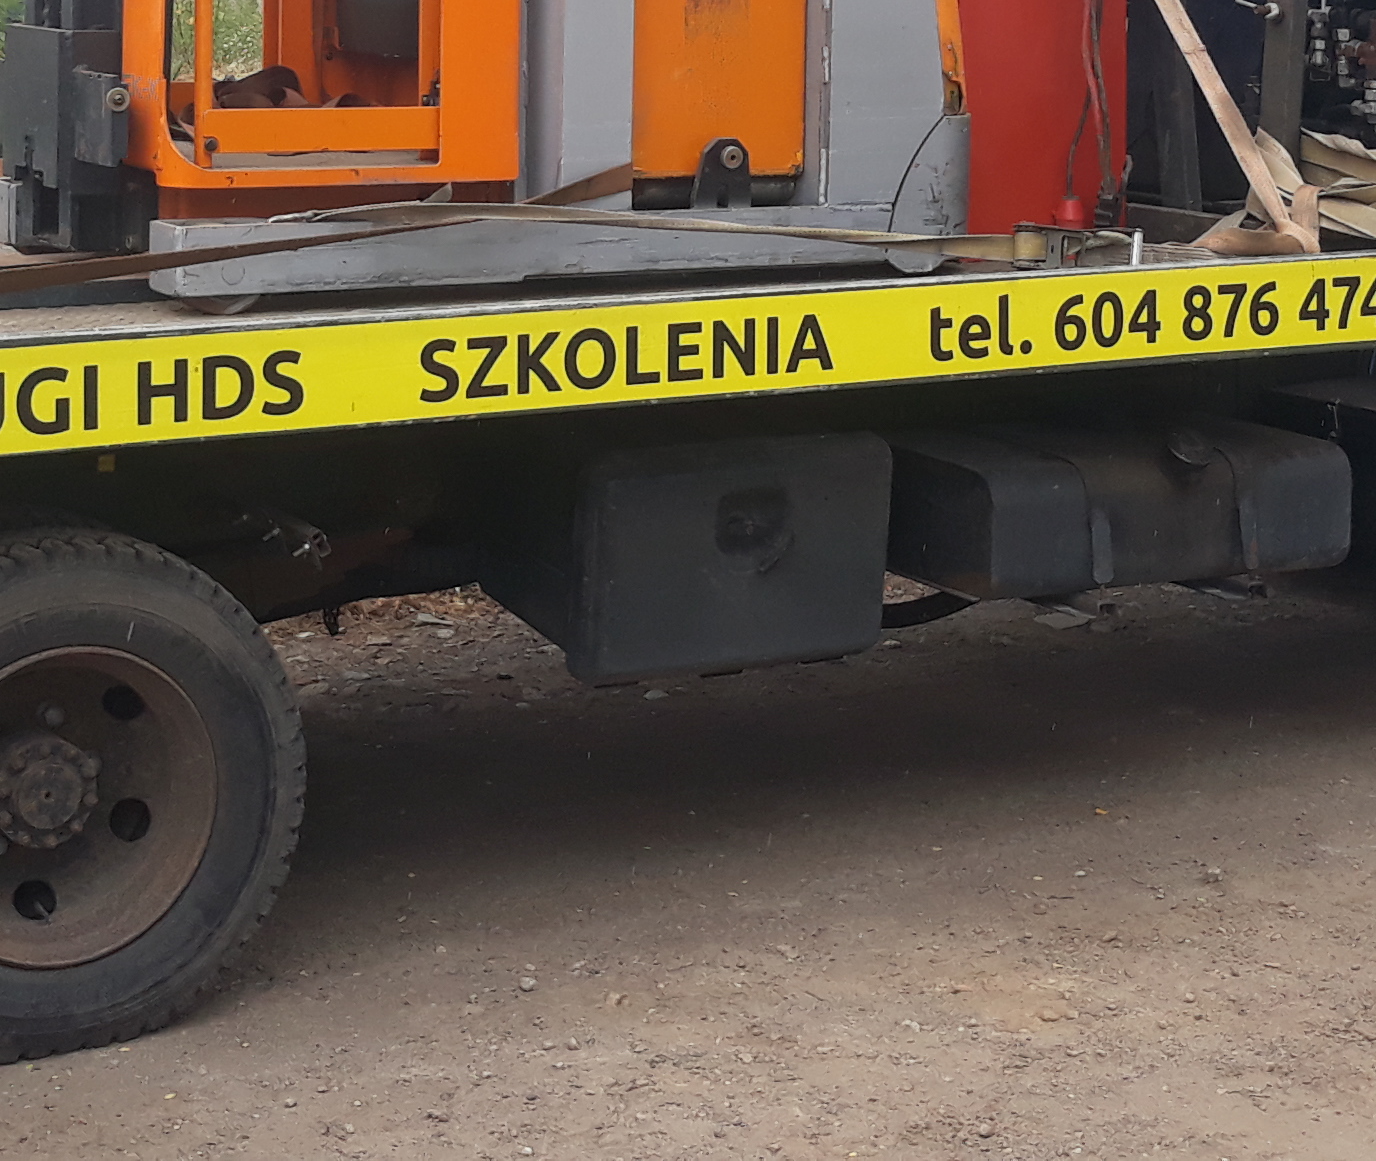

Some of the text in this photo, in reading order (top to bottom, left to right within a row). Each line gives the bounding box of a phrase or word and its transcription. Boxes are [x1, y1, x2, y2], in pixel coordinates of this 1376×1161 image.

[137, 350, 304, 426] HDS
[419, 313, 834, 403] SZKOLENIA
[930, 293, 1033, 362] tel.
[1054, 289, 1161, 351] 604
[1182, 280, 1279, 341] 876
